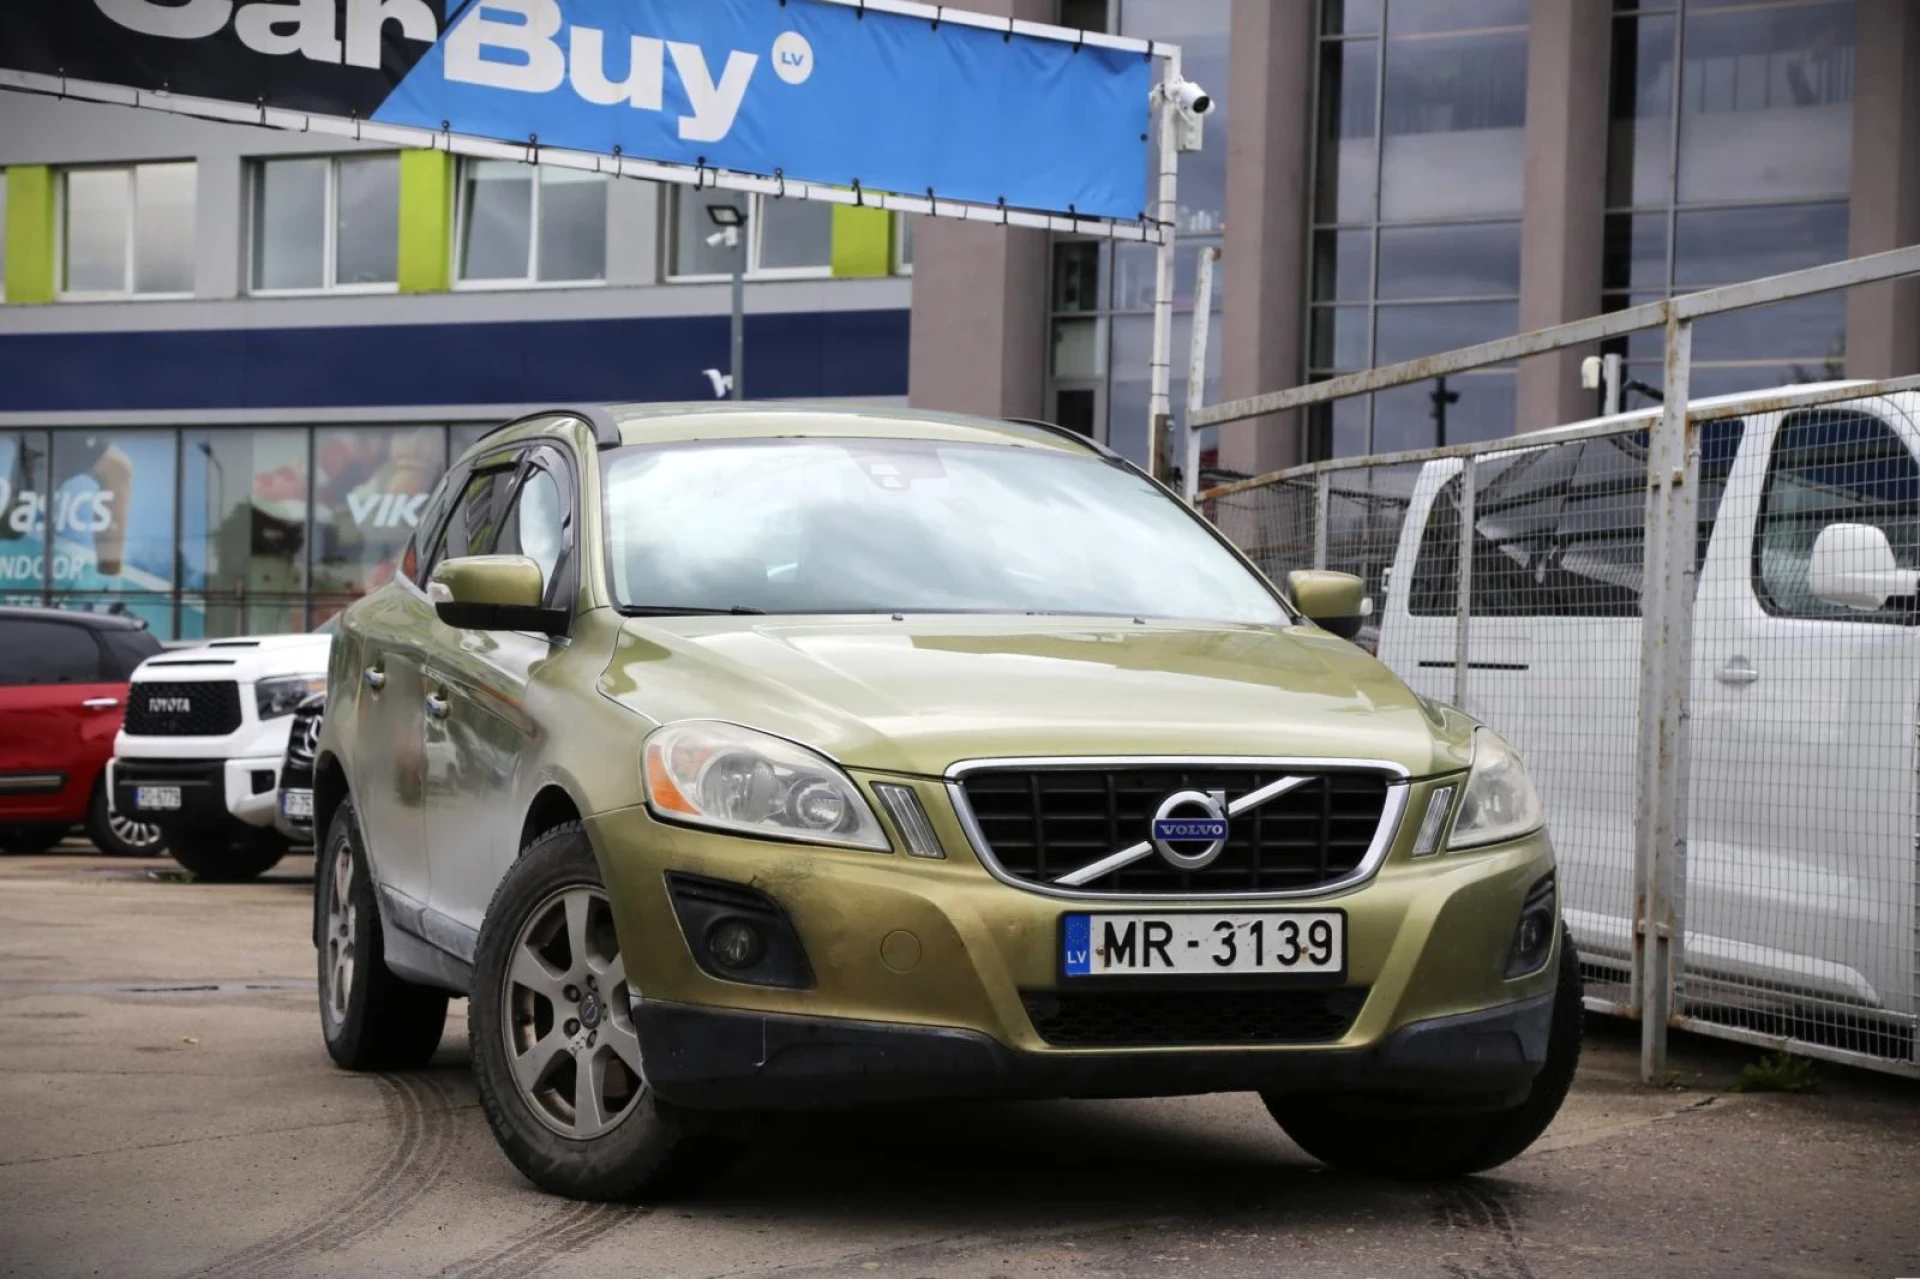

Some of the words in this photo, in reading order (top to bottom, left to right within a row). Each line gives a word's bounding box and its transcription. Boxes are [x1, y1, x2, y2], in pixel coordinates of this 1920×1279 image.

[781, 51, 804, 66] LV
[1160, 824, 1224, 836] VOLVO
[1103, 919, 1333, 968] MR-3139
[1067, 950, 1087, 964] LV
